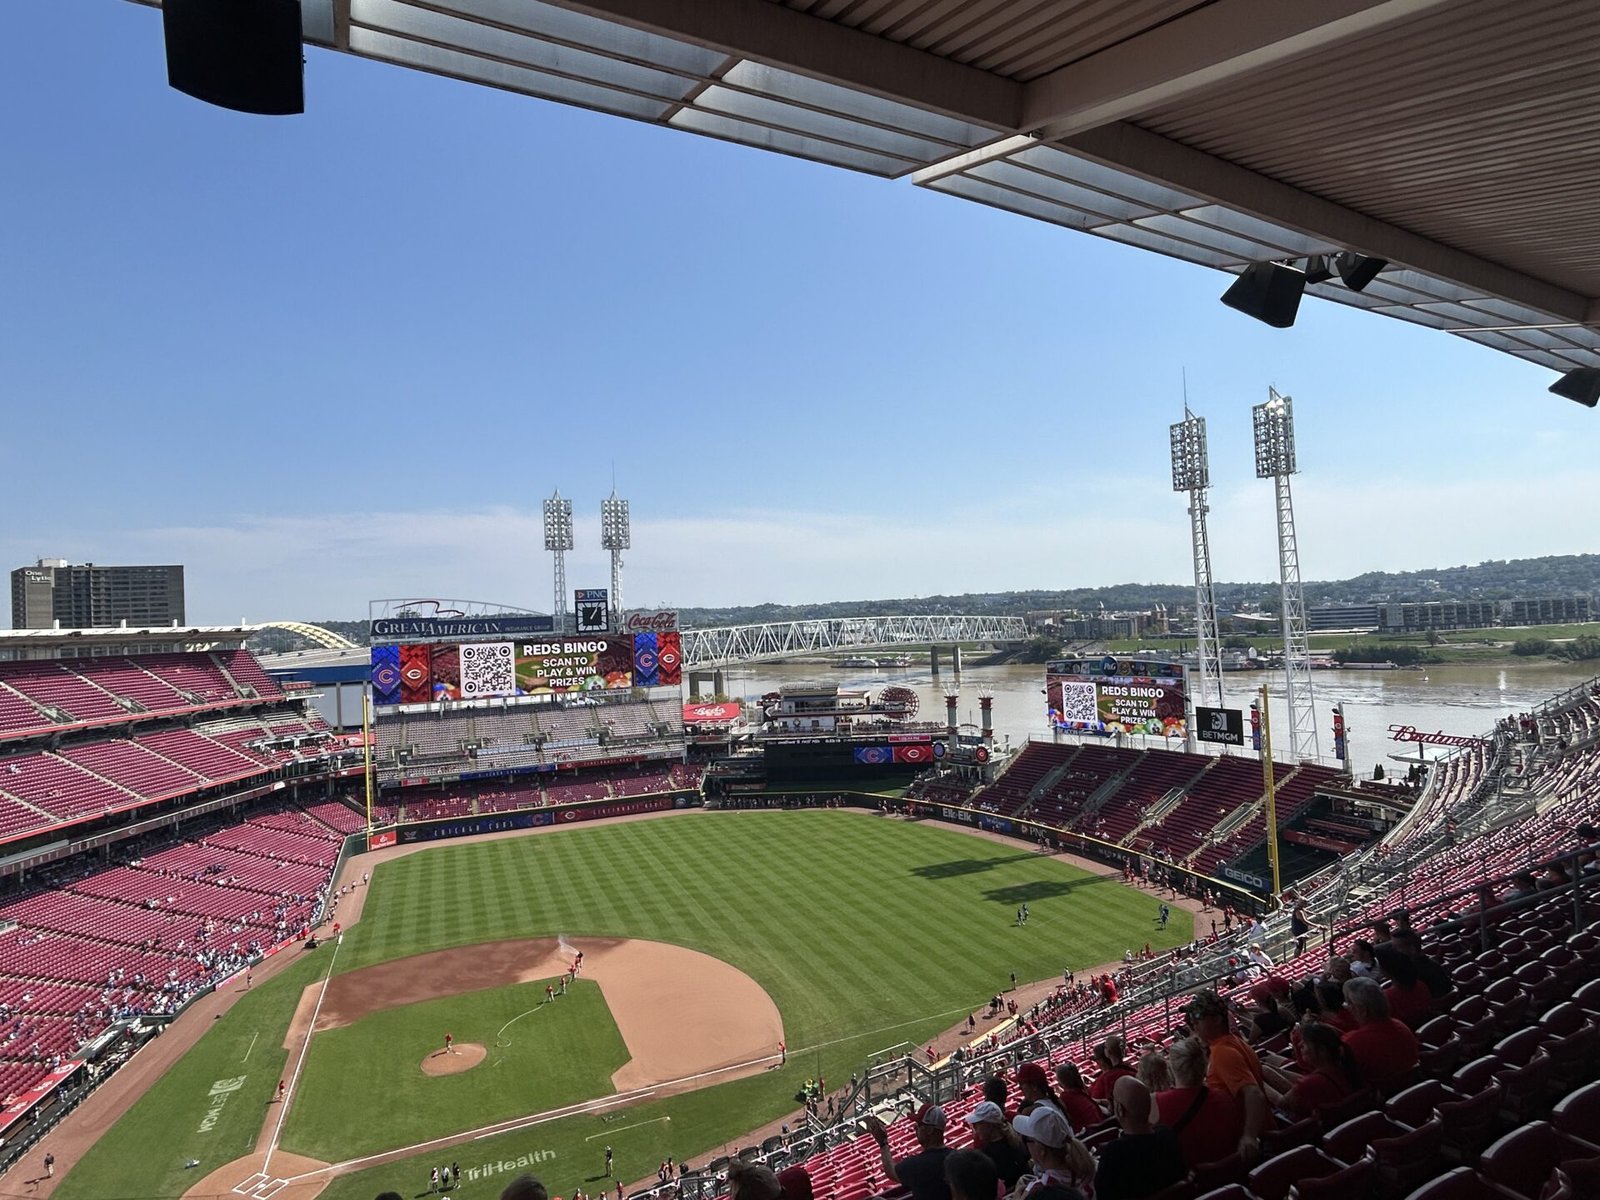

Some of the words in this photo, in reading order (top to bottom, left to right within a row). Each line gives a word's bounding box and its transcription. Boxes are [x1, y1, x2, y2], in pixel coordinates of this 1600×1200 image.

[586, 590, 607, 598] PNC
[628, 611, 678, 630] Coca-Cola
[423, 622, 502, 636] AMERICAN
[523, 644, 561, 656] REDS
[563, 641, 608, 654] BINGO
[542, 658, 572, 667] SCAN
[573, 656, 588, 665] TO
[537, 668, 563, 678] PLAY
[565, 668, 573, 676] &
[576, 666, 597, 675] WIN
[549, 677, 585, 687] PRIZES
[1101, 686, 1128, 696] REDS
[1130, 687, 1164, 698] BINGO
[1115, 699, 1136, 707] SCAN
[1138, 700, 1148, 708] TO
[1139, 709, 1156, 717] WIN
[1120, 716, 1147, 725] PRIZES
[1202, 730, 1238, 741] BETMGM
[1029, 826, 1048, 838] PNC
[1224, 867, 1263, 888] GEICO
[463, 1149, 557, 1181] TriHealth
